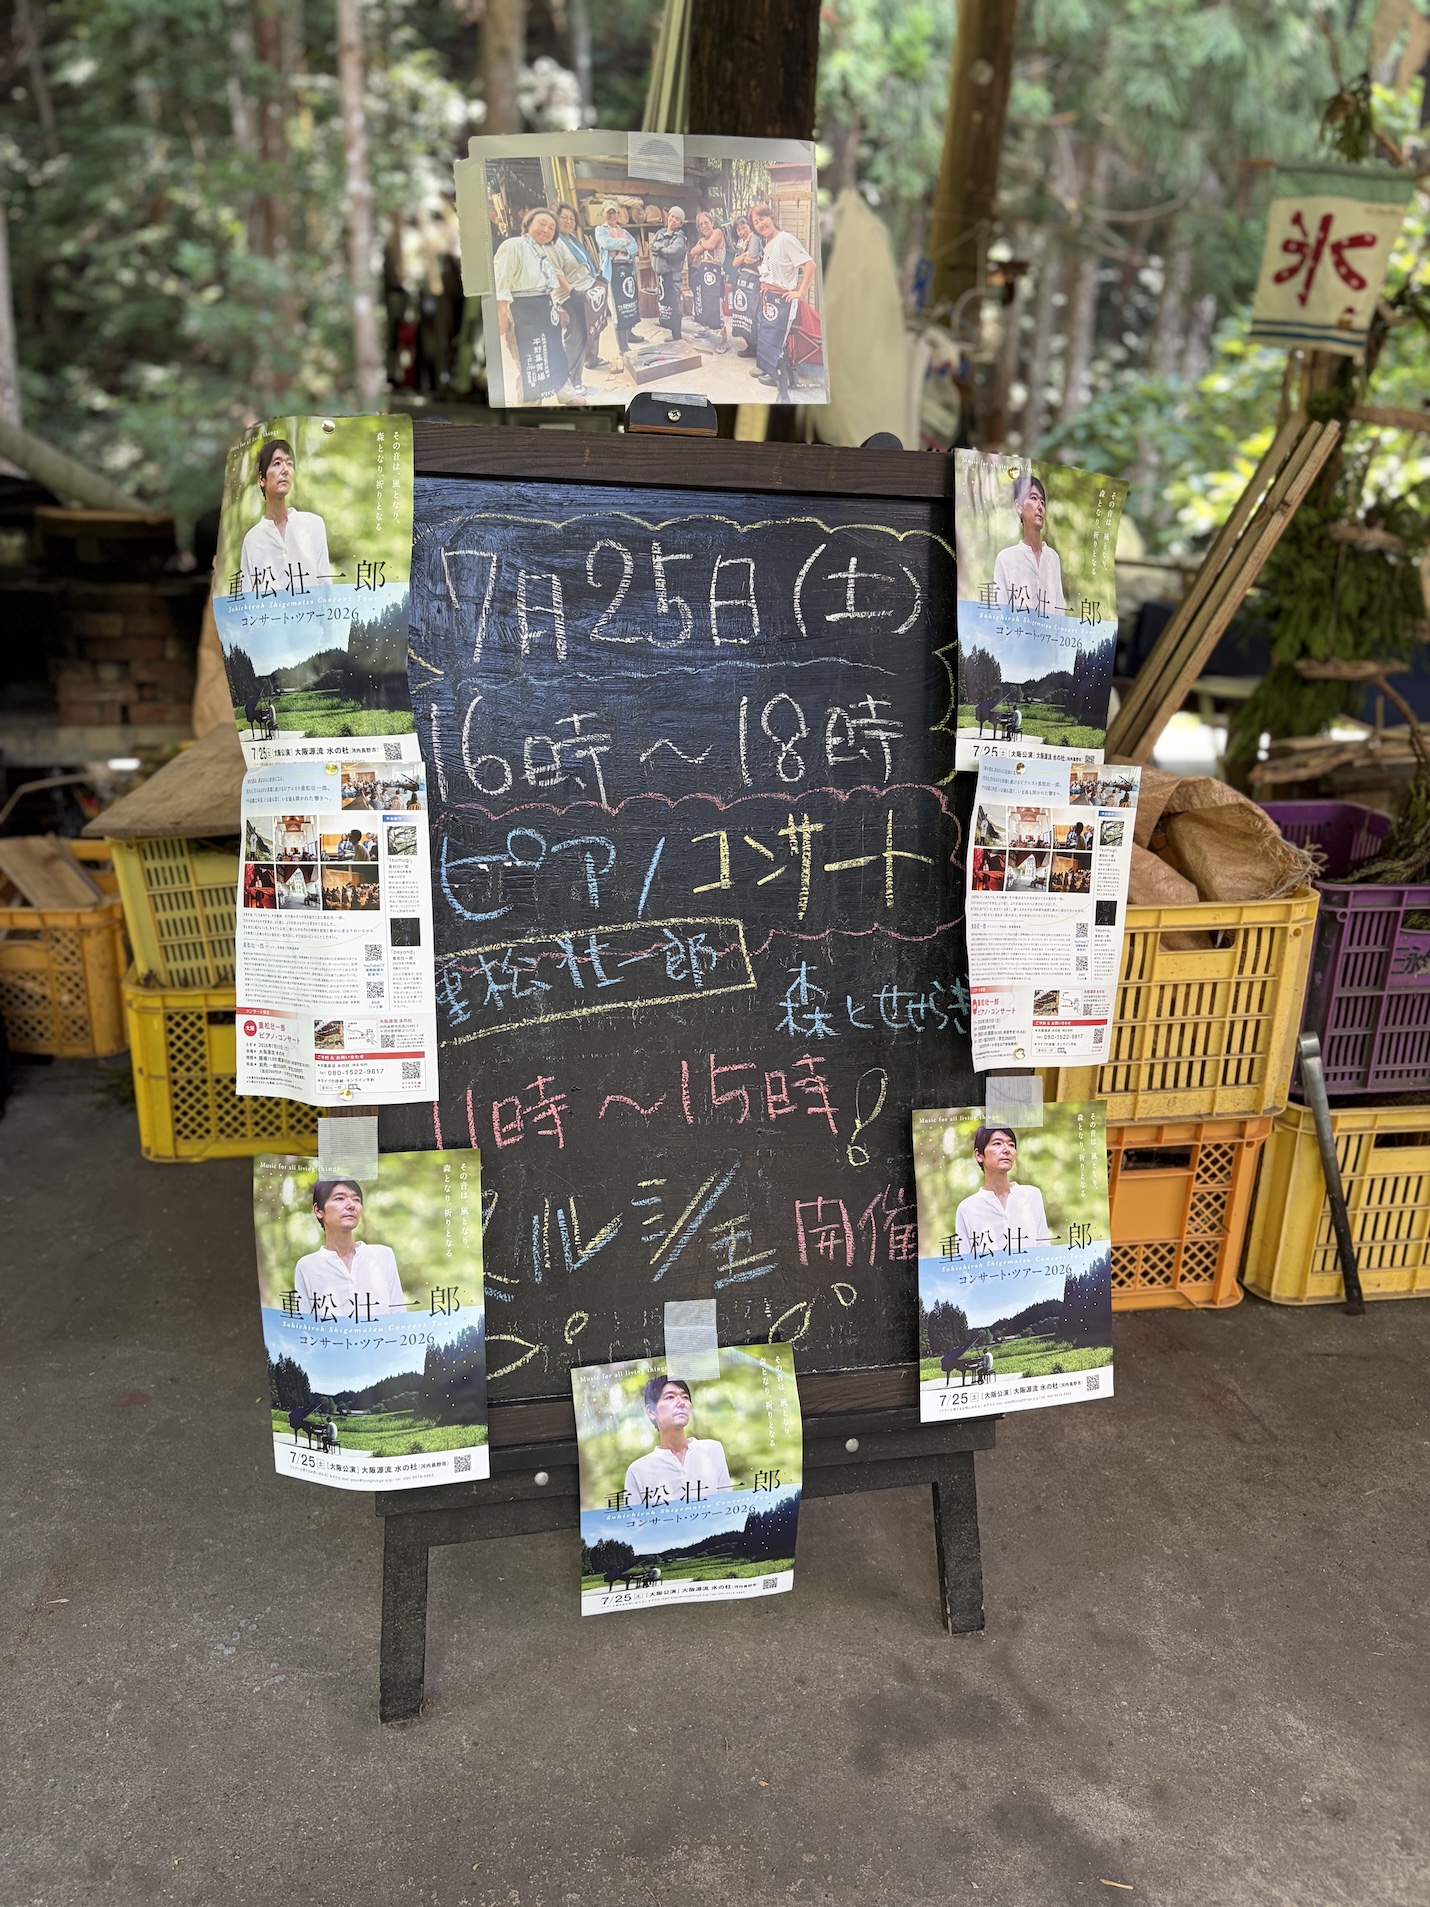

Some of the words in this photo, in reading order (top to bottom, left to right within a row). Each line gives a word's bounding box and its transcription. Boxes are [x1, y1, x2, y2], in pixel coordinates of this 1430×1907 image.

[1272, 210, 1378, 309] 氷
[375, 431, 386, 532] 森となり、祈りとなる
[392, 431, 401, 524] その音は、風となり、
[1091, 489, 1107, 576] 森となり、祈りとなる
[1101, 491, 1117, 572] その音は、風となり、
[227, 559, 387, 604] 重松壮一郎
[317, 596, 351, 604] Concert
[440, 538, 922, 664] 7月25日(土)
[977, 580, 1102, 627] 重松壮一郎
[242, 606, 360, 628] コンサート・ツアー2026
[995, 626, 1083, 649] コンサート・ツアー2026
[973, 745, 998, 757] 7/25
[435, 928, 718, 1028] 重松壮一郎
[258, 1021, 286, 1032] 重松壮一郎
[259, 1032, 300, 1045] ピアノ・コンサート
[327, 1068, 385, 1076] 080-1522-9817
[260, 1161, 277, 1169] Music
[278, 1162, 287, 1170] for
[297, 1164, 316, 1173] living
[1077, 1113, 1086, 1198] 森となり、祈りとなる
[1089, 1112, 1099, 1190] その音は、風となり、
[443, 1163, 453, 1258] 森となり、祈りとなる
[459, 1162, 470, 1249] その音は、風となり、
[938, 1222, 1092, 1264] 重松壮一郎
[941, 1262, 984, 1273] Sohichiroh
[986, 1257, 1032, 1267] Shigematsu
[1035, 1254, 1066, 1262] Concert
[958, 1263, 1073, 1285] コンサート・ツアー2026
[278, 1285, 461, 1325] 重松壮一郎
[282, 1320, 325, 1333] Sohichiroh
[328, 1325, 384, 1335] Shigematsu
[388, 1321, 427, 1331] Concert
[431, 1319, 455, 1328] Tour
[299, 1331, 435, 1350] コンサート・ツアー2026
[579, 1375, 600, 1383] Music
[614, 1370, 623, 1378] all
[759, 1357, 776, 1447] 森となり、祈りとなる
[775, 1355, 792, 1438] その音は、風となり、
[939, 1393, 968, 1407] 7/25
[981, 1388, 1013, 1400] [大阪公演]
[1013, 1385, 1039, 1395] 大阪源流
[1039, 1382, 1059, 1391] 水の杜
[289, 1451, 316, 1468] 7/25
[326, 1461, 360, 1474] [大阪公演]
[361, 1465, 392, 1474] 大阪源流
[394, 1463, 418, 1473] 水の杜
[604, 1469, 781, 1515] 重松壮一郎
[606, 1510, 656, 1521] Sohichiroh
[659, 1503, 712, 1514] Shigematsu
[715, 1497, 750, 1507] Concert
[626, 1503, 757, 1528] コンサート・ツアー2026
[601, 1593, 632, 1605] 7/25
[681, 1585, 710, 1594] 大阪源流
